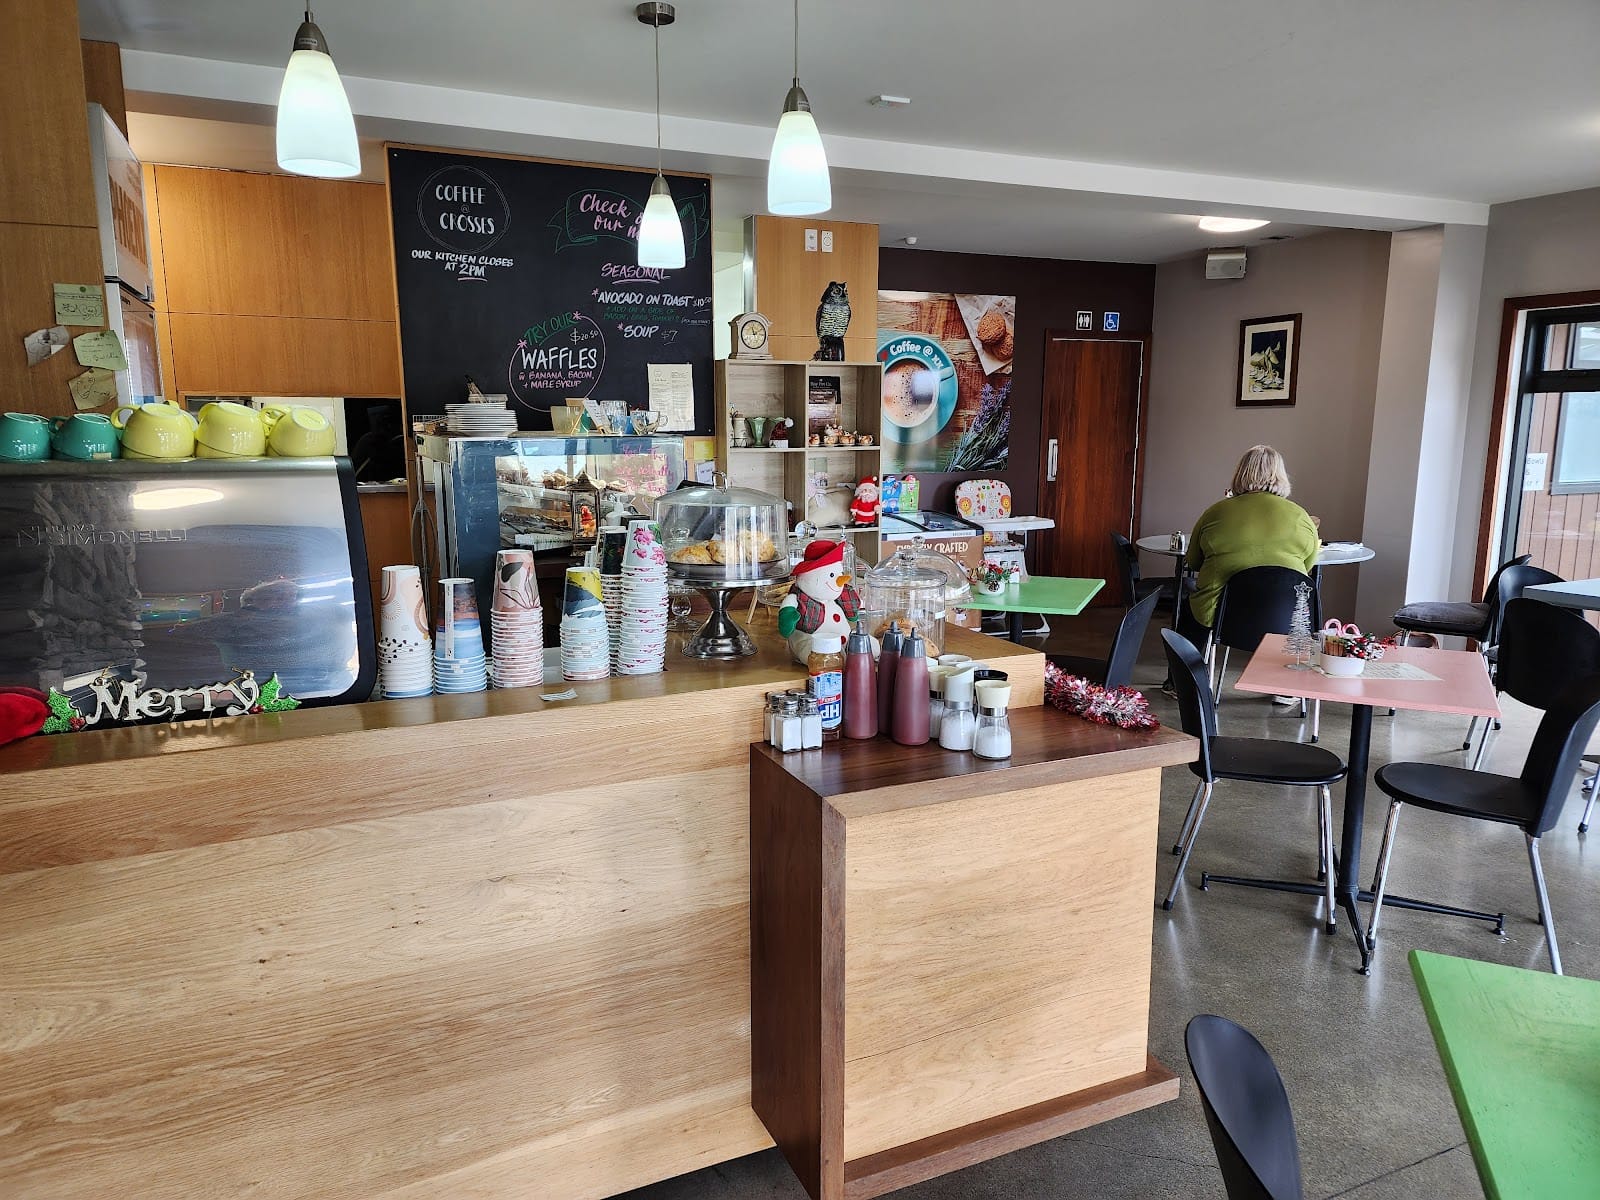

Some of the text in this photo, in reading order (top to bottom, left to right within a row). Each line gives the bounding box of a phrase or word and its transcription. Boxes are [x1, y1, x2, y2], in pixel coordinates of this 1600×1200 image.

[435, 184, 487, 204] COFFEE
[579, 193, 631, 218] Check
[439, 212, 495, 235] CROSSES
[593, 214, 626, 232] our
[411, 249, 514, 267] OUR KITCHEN CLOSES
[444, 261, 487, 277] AT 2PM
[601, 262, 671, 281] SEASONAL
[597, 290, 644, 305] AVOCADO
[645, 293, 661, 305] ON
[662, 293, 695, 307] TOAST
[523, 311, 580, 346] TRY OUR
[624, 324, 660, 339] SOUP
[889, 340, 922, 356] Coffee
[922, 345, 934, 357] @
[521, 346, 598, 370] WAFFLES
[530, 380, 555, 389] MAPLE
[555, 380, 582, 388] SYRUP
[934, 541, 969, 554] CRAFTED
[85, 676, 260, 726] Merry
[820, 703, 840, 719] HP
